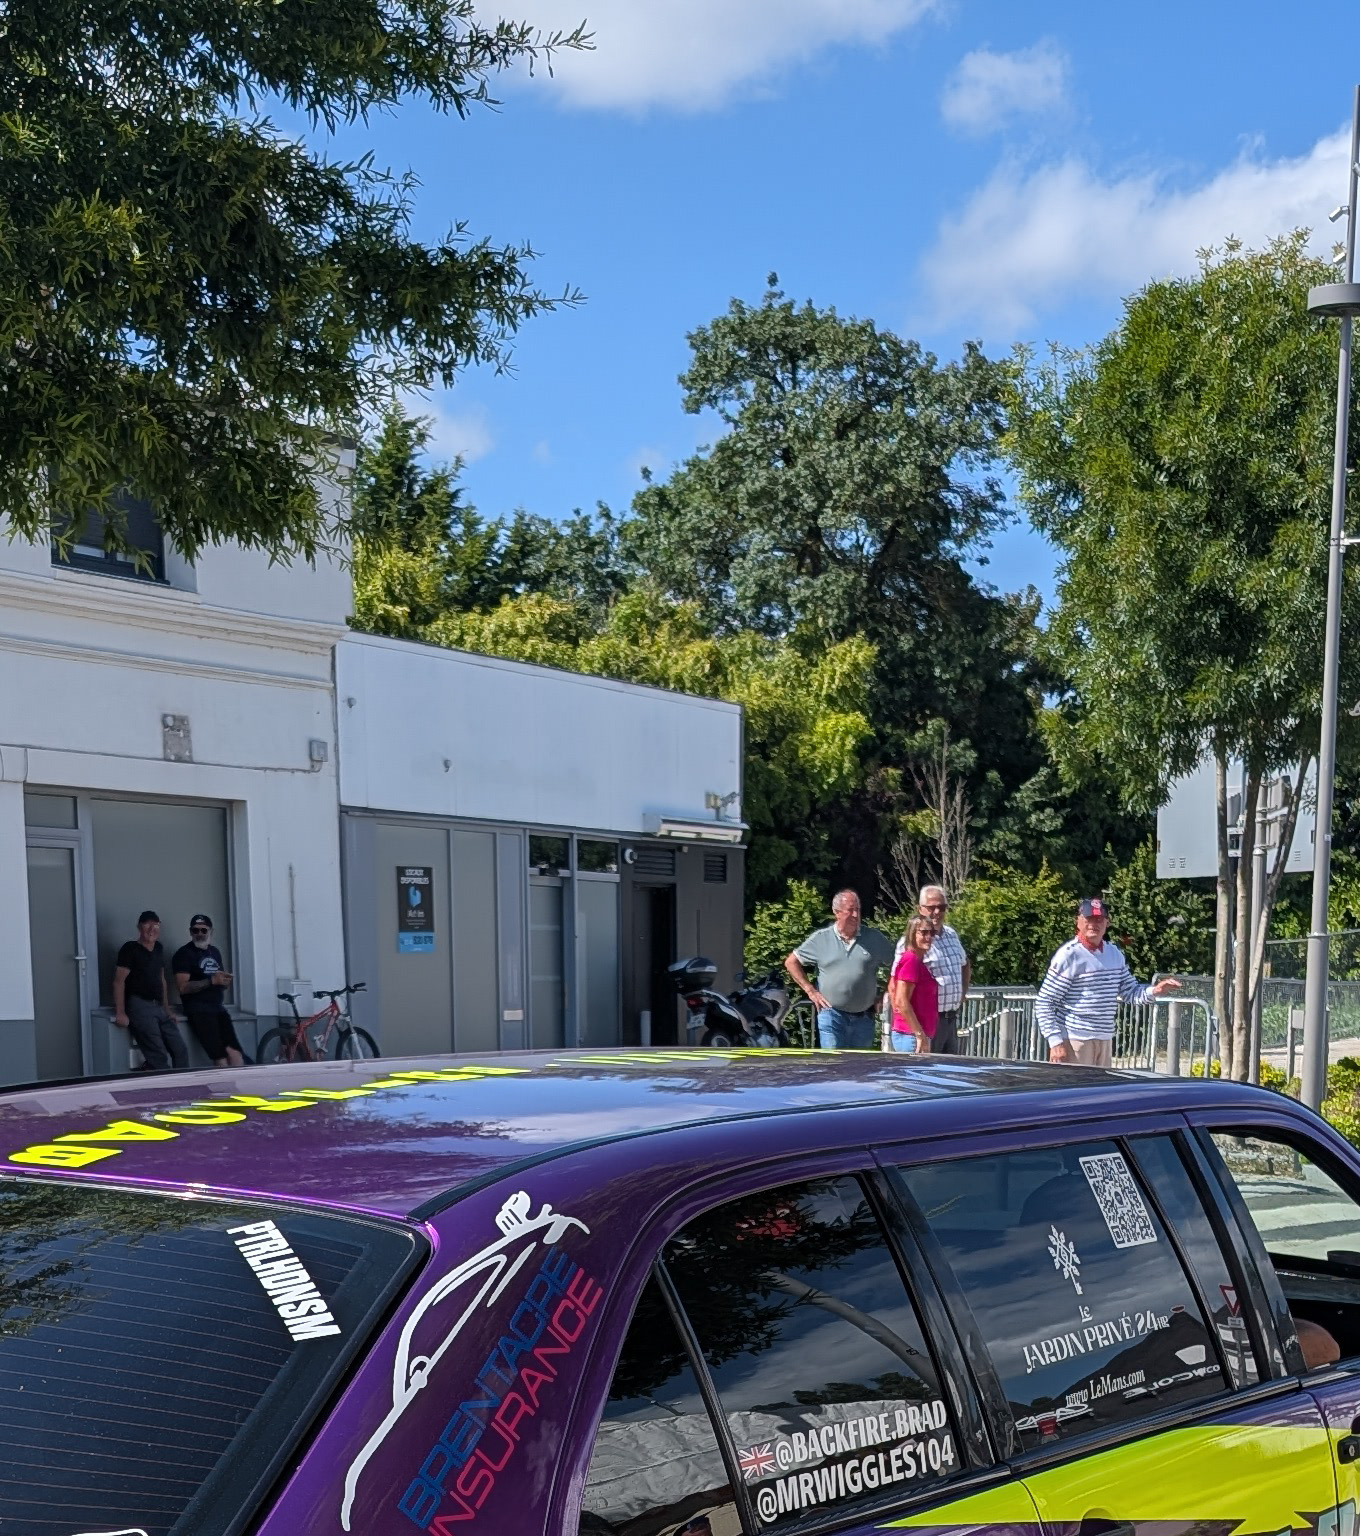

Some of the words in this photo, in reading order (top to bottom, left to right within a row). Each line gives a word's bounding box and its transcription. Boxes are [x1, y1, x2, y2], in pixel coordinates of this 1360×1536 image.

[226, 1219, 342, 1342] PTRLHDNSM
[1023, 1330, 1085, 1374] JARDIN
[1084, 1311, 1136, 1351] PRIVÉ
[397, 1246, 579, 1530] BRENTACRE
[757, 1434, 955, 1523] @MRWIGGLES104
[775, 1399, 947, 1471] @BACKFIRE.BRAD
